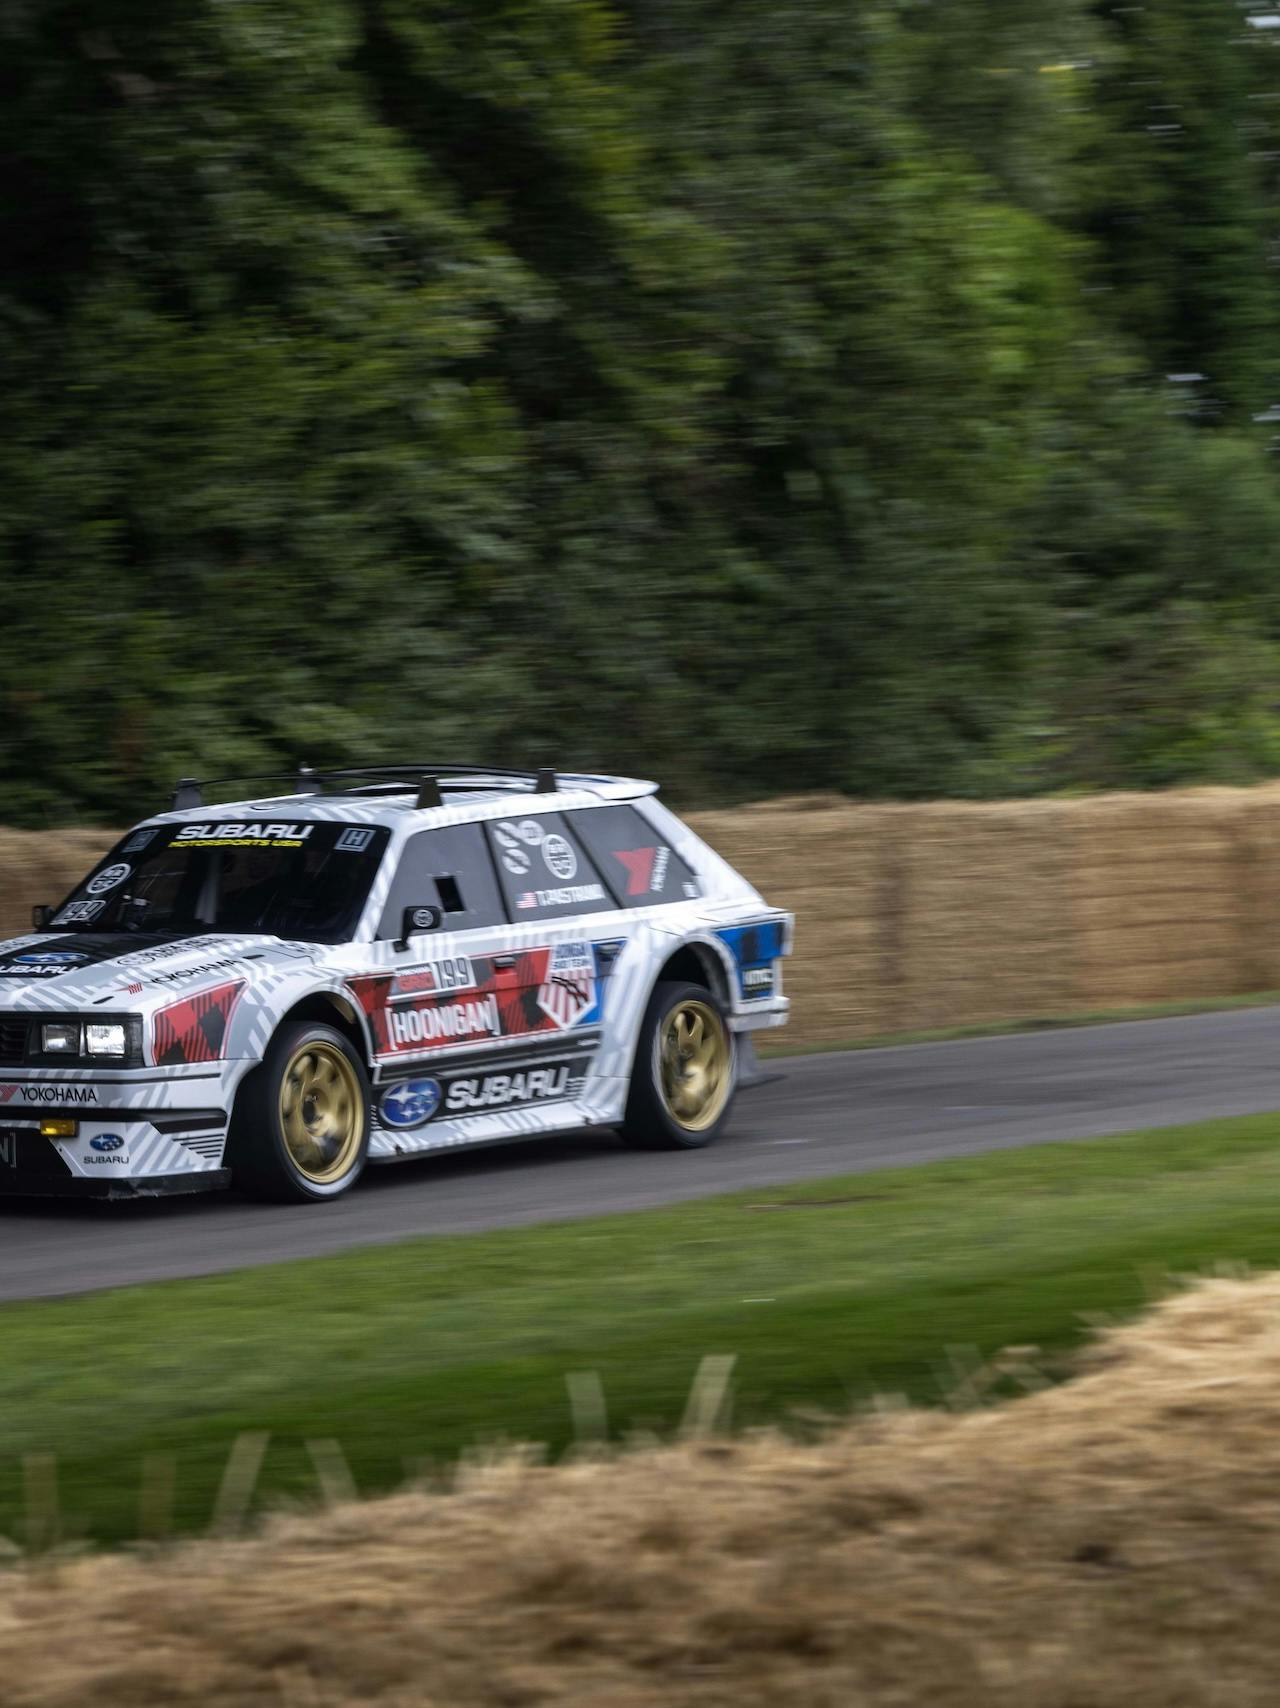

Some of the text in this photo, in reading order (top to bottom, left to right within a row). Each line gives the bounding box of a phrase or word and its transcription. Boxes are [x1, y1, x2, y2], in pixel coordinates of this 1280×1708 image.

[176, 824, 314, 839] SUBARU
[436, 958, 470, 989] 199
[20, 1087, 97, 1103] YOKOHAMA
[446, 1066, 568, 1110] SUBARU
[83, 1155, 129, 1165] SUBARU
